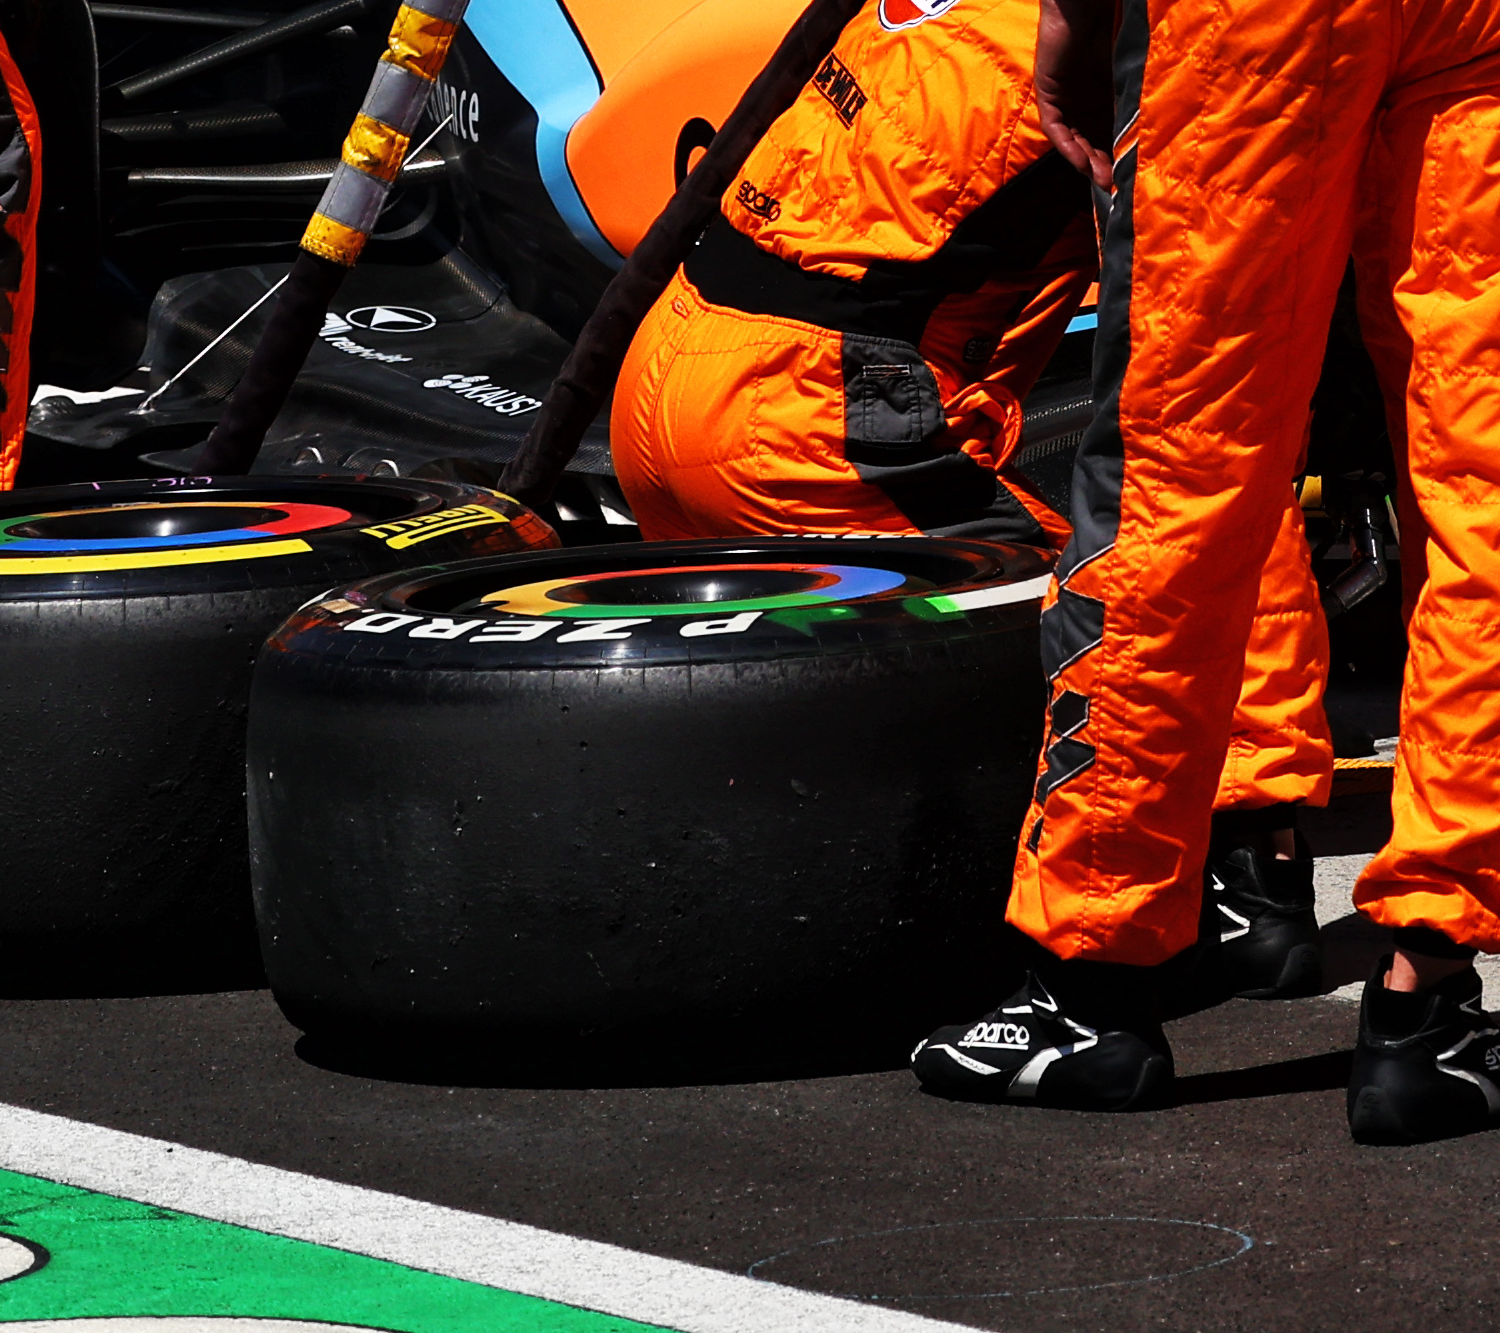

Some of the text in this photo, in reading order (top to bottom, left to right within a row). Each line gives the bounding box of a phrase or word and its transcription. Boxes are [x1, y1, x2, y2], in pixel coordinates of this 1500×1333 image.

[343, 610, 764, 645] P ZERO
[963, 1021, 1031, 1048] sparco
